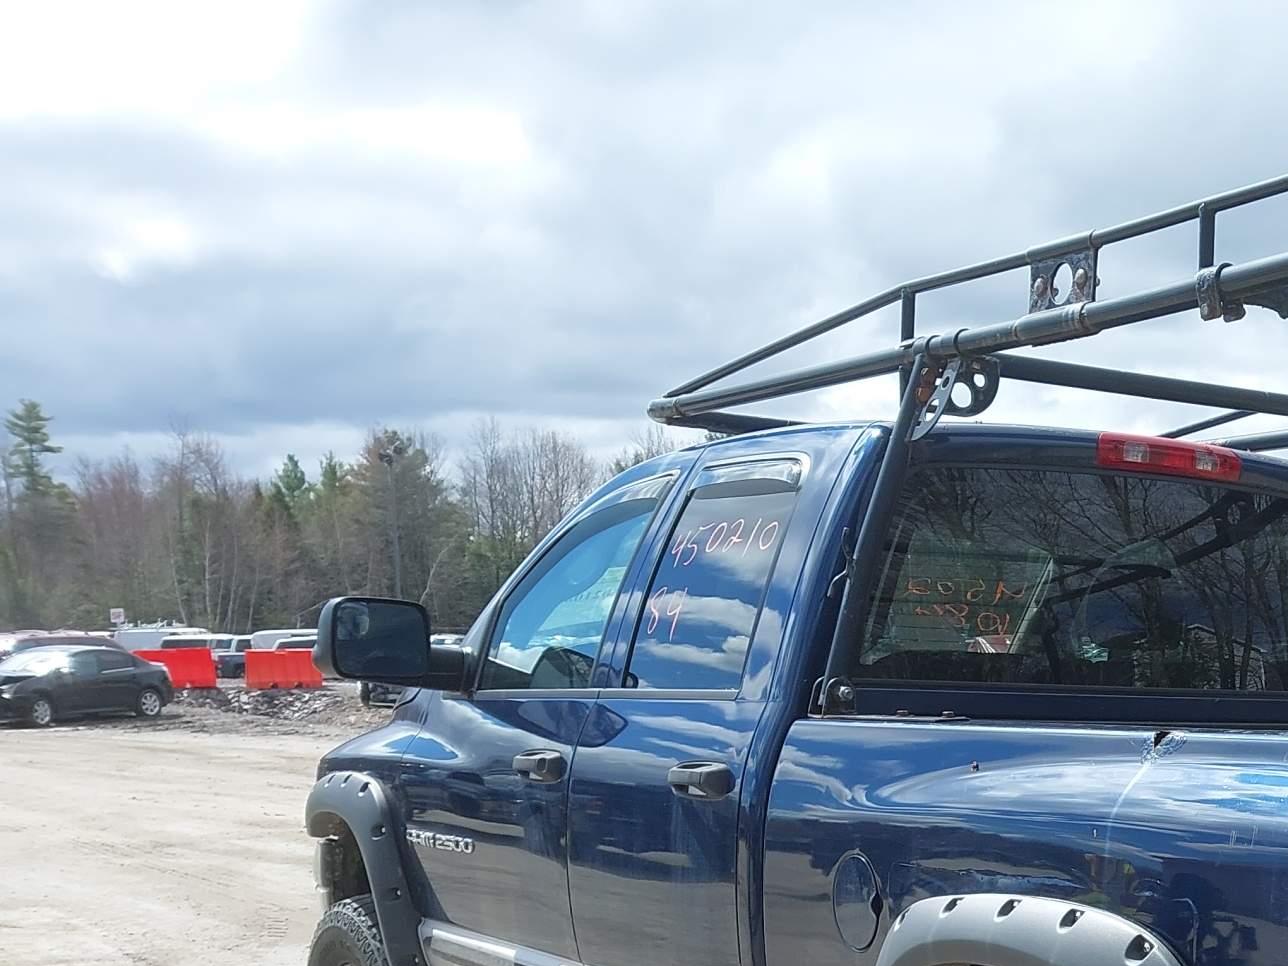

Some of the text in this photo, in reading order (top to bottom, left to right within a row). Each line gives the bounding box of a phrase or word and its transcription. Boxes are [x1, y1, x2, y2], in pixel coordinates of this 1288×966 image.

[671, 517, 779, 568] 450210
[647, 586, 688, 642] 84
[434, 833, 475, 854] 2500
